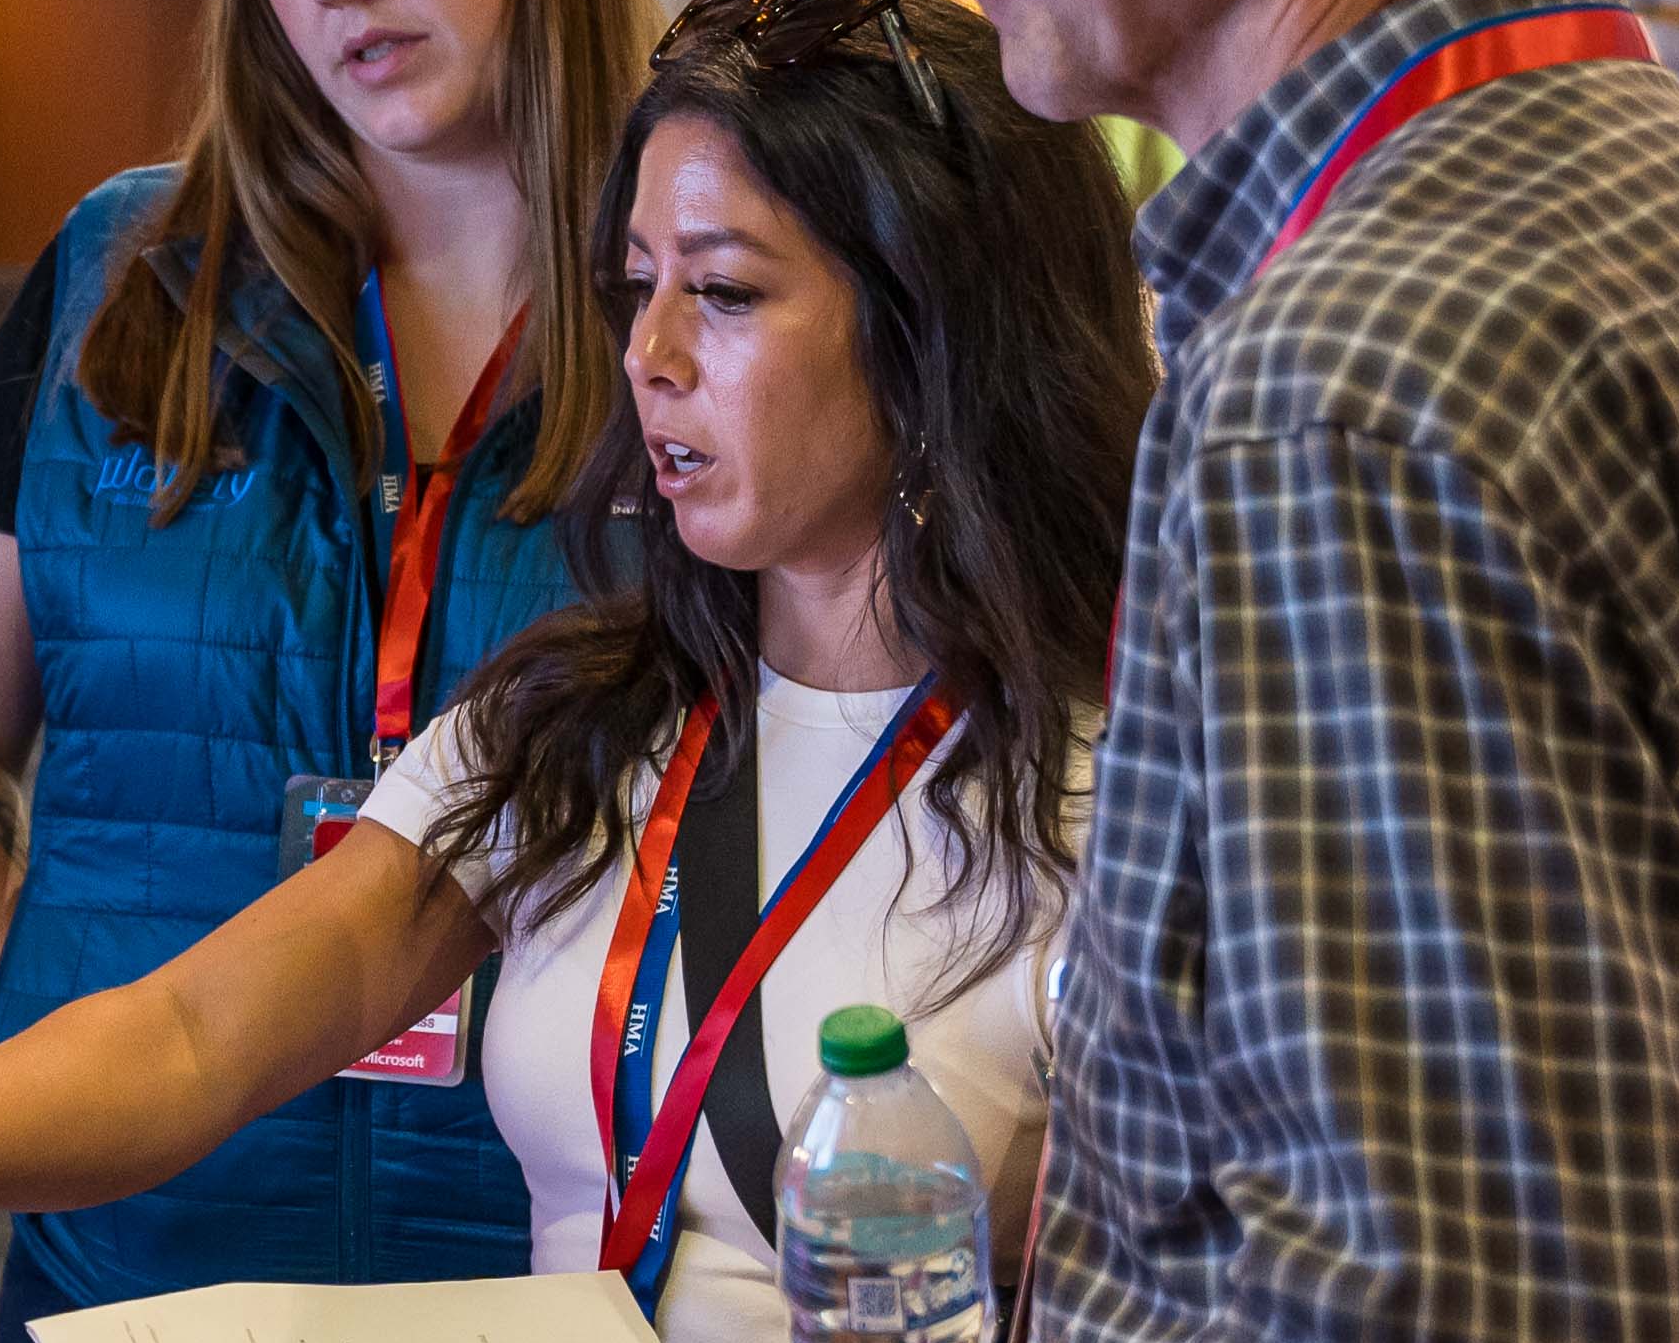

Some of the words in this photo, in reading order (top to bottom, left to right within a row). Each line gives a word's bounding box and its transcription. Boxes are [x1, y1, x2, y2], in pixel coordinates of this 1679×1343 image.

[654, 865, 679, 916] HMA
[623, 1002, 649, 1057] HMA
[359, 1053, 425, 1069] Microsoft
